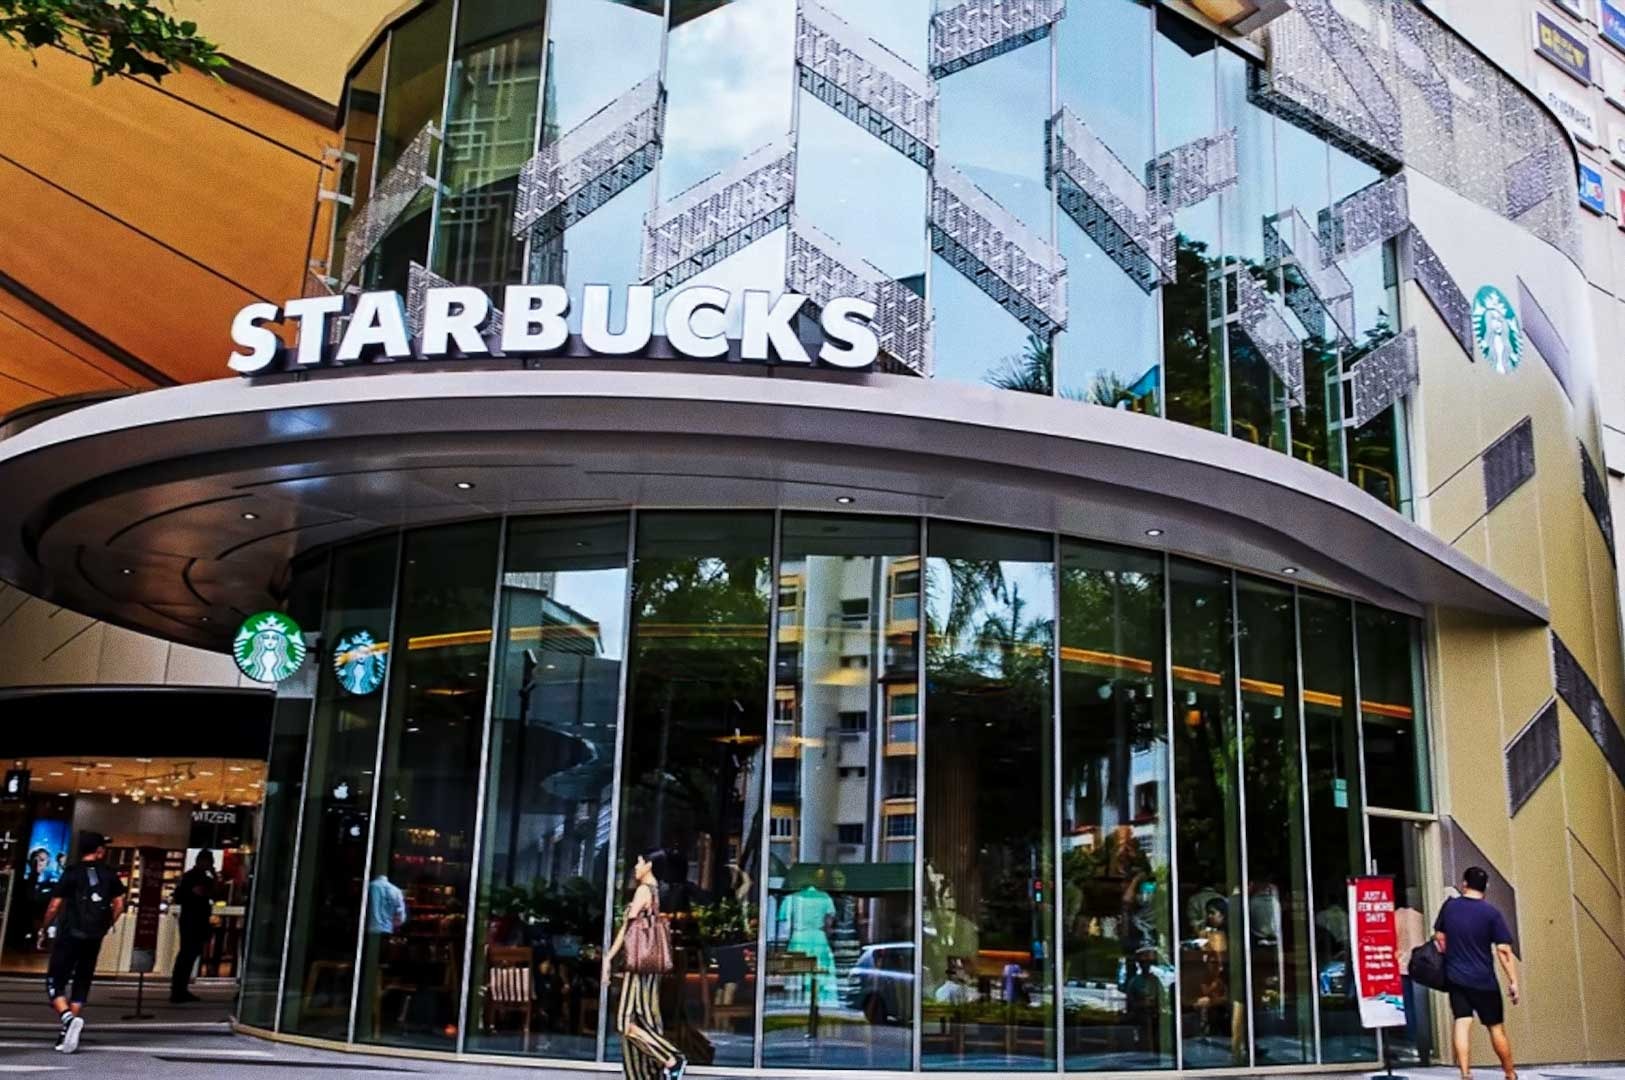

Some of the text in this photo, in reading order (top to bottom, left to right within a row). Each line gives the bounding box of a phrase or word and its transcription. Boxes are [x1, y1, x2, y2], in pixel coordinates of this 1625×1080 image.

[227, 284, 880, 373] STARBUCKS
[1363, 891, 1381, 901] JUST
[1365, 912, 1387, 923] DAYS
